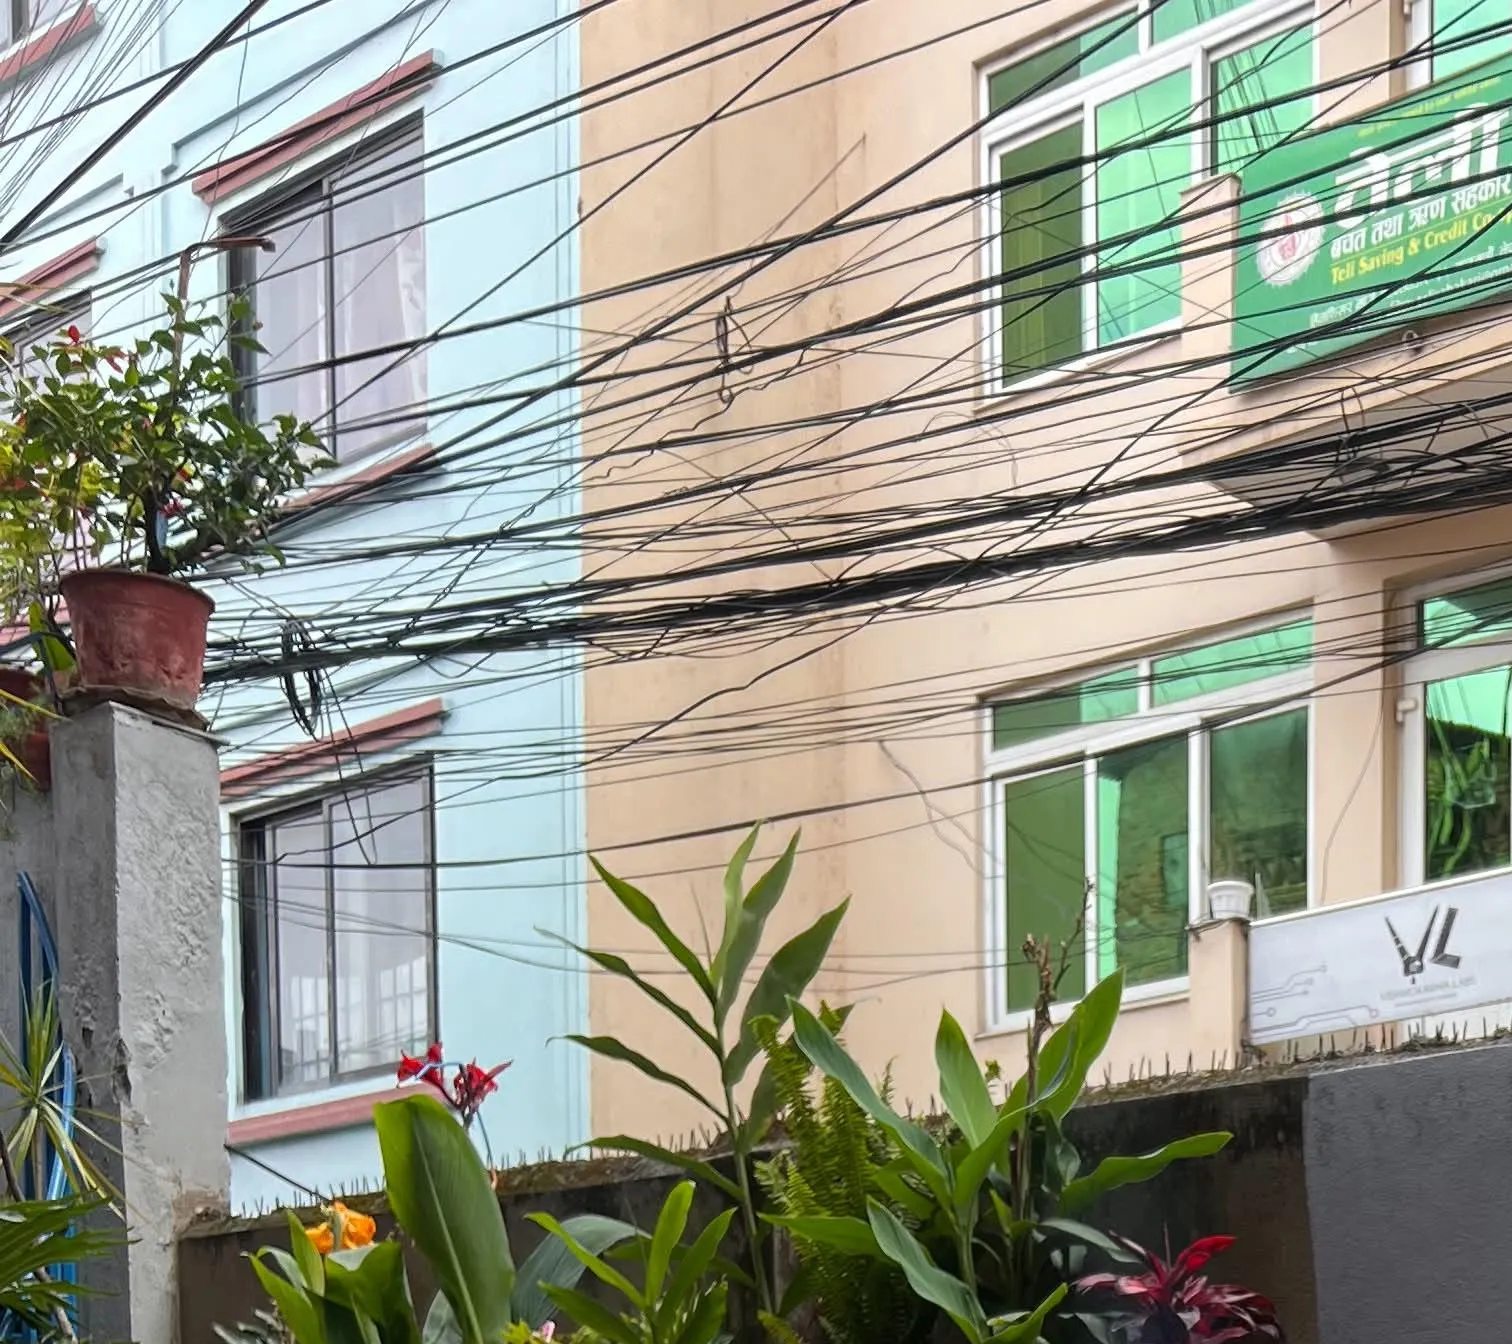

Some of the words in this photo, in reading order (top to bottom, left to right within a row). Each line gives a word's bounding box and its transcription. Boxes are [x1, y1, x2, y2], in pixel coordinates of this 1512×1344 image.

[1331, 227, 1367, 259] बचत
[1371, 213, 1404, 244] तथा
[1332, 260, 1355, 285] Teli
[1358, 246, 1405, 275] Saving
[1408, 237, 1420, 256] &
[1424, 220, 1468, 250] Credit
